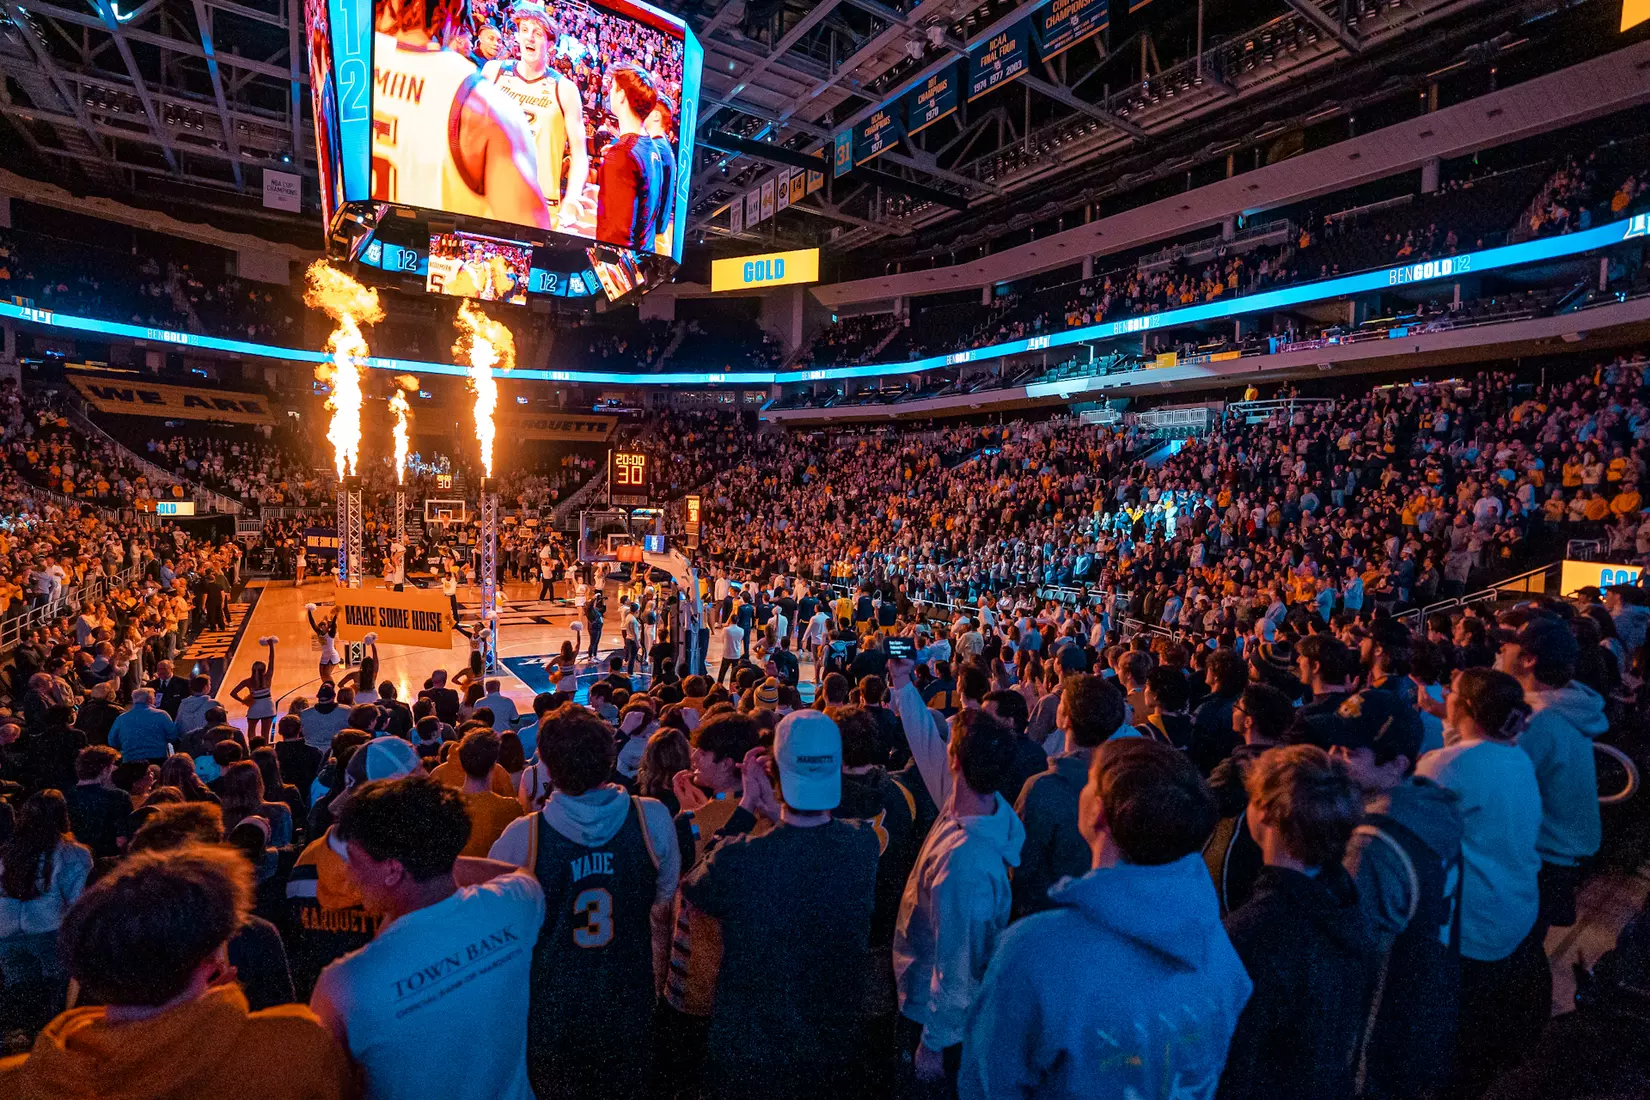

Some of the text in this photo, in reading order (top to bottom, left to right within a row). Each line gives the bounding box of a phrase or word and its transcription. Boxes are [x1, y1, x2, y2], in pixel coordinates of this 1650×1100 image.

[980, 39, 1016, 67] FINAL FOUR
[837, 141, 850, 166] 31
[266, 185, 298, 196] CHAMPIONS
[397, 249, 418, 271] 12
[743, 258, 785, 283] GOLD
[540, 272, 558, 292] 12
[87, 385, 266, 414] WE ARE
[616, 454, 645, 466] 20:00
[437, 480, 450, 489] 30
[618, 465, 642, 485] 30
[344, 604, 443, 633] MAKE SOME NOISE
[570, 851, 615, 883] WADE
[573, 887, 615, 949] 3
[391, 924, 519, 998] TOWN BANK
